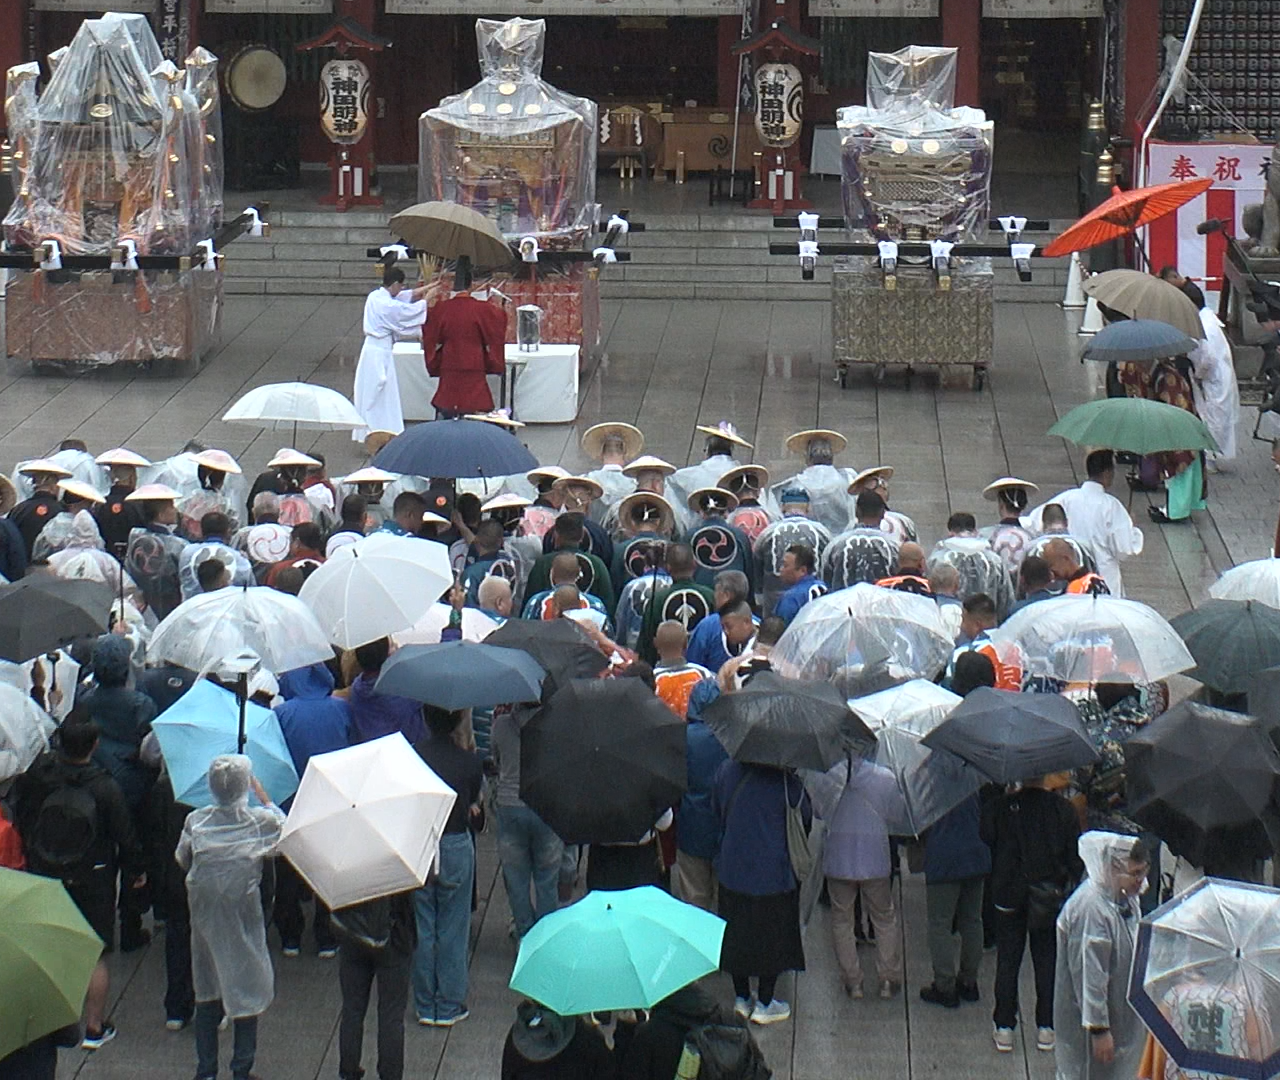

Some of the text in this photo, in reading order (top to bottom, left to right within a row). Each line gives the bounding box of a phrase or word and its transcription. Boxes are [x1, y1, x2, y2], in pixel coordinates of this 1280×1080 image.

[331, 77, 359, 133] 神田明神
[759, 81, 786, 138] 神田明神
